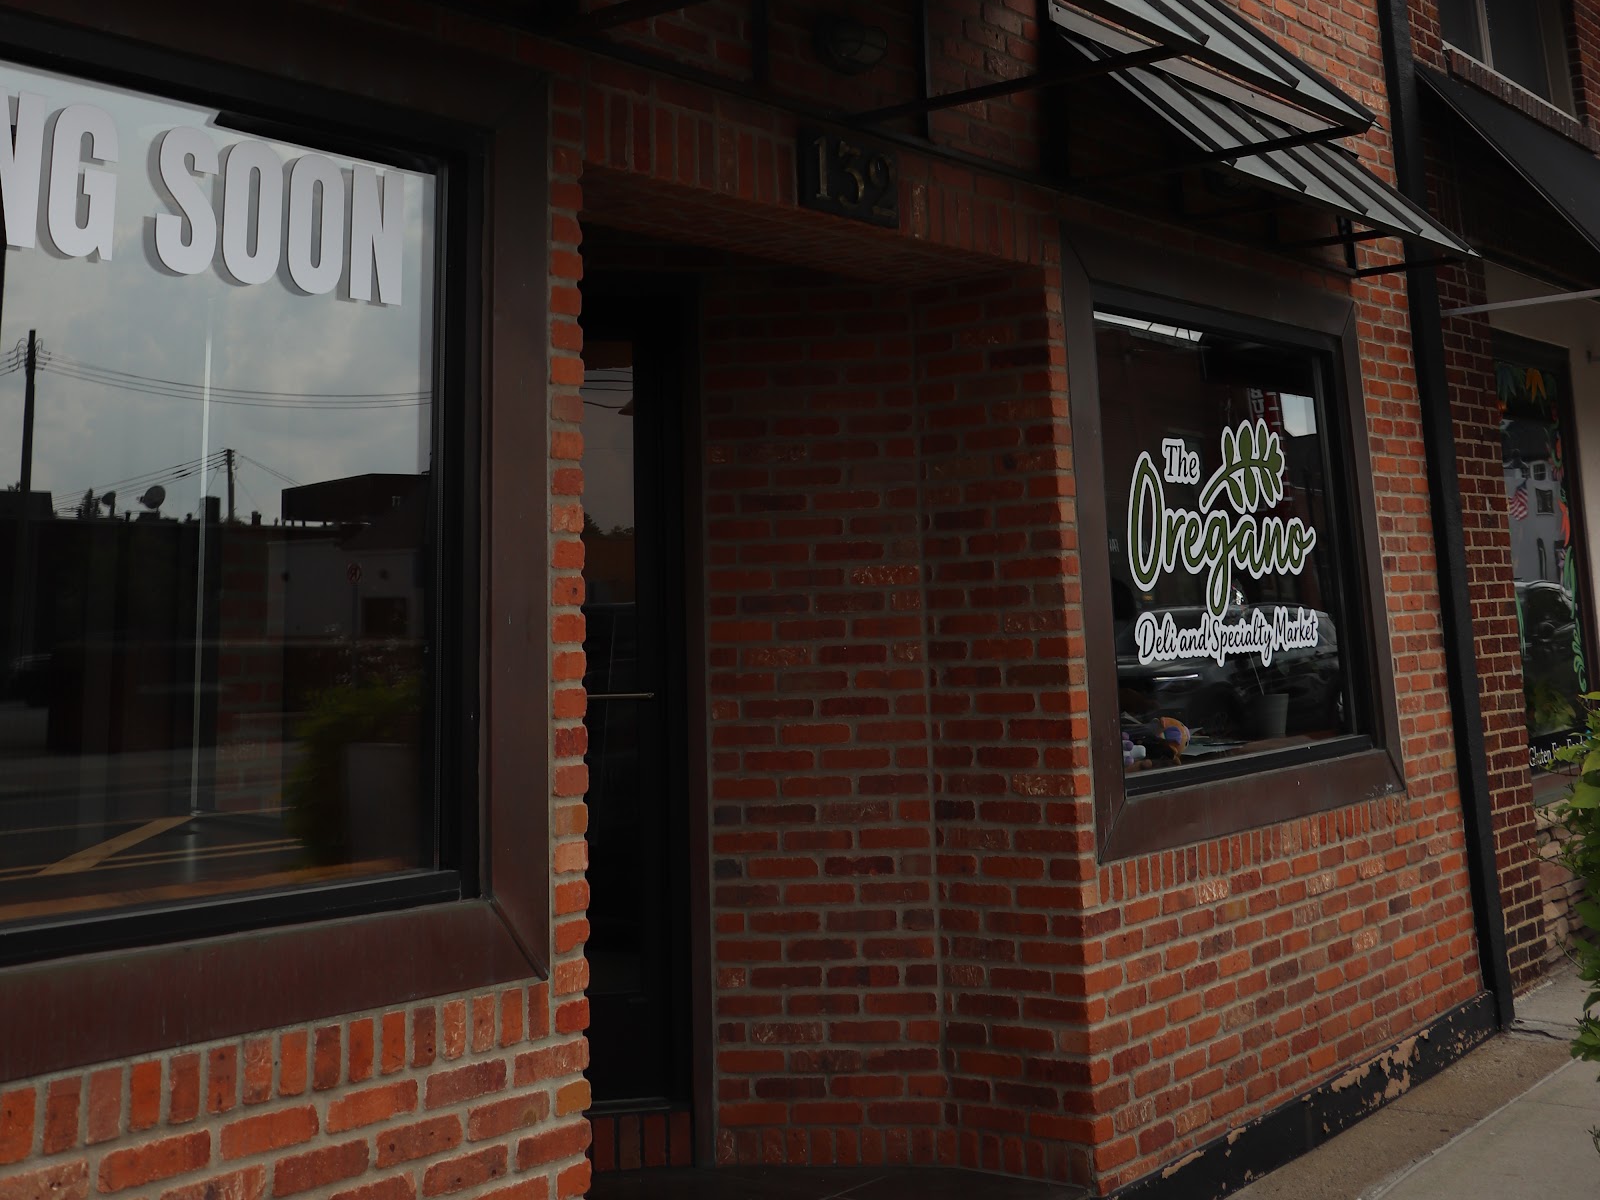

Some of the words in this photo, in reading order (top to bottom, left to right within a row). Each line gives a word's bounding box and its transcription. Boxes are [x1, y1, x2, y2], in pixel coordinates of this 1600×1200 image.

[155, 126, 404, 305] SOON
[1163, 441, 1199, 482] The
[1128, 451, 1316, 616] Oregano
[1137, 615, 1177, 661] Deli
[1179, 615, 1209, 655] and
[1210, 615, 1273, 664] Specialty
[1275, 610, 1317, 647] Market
